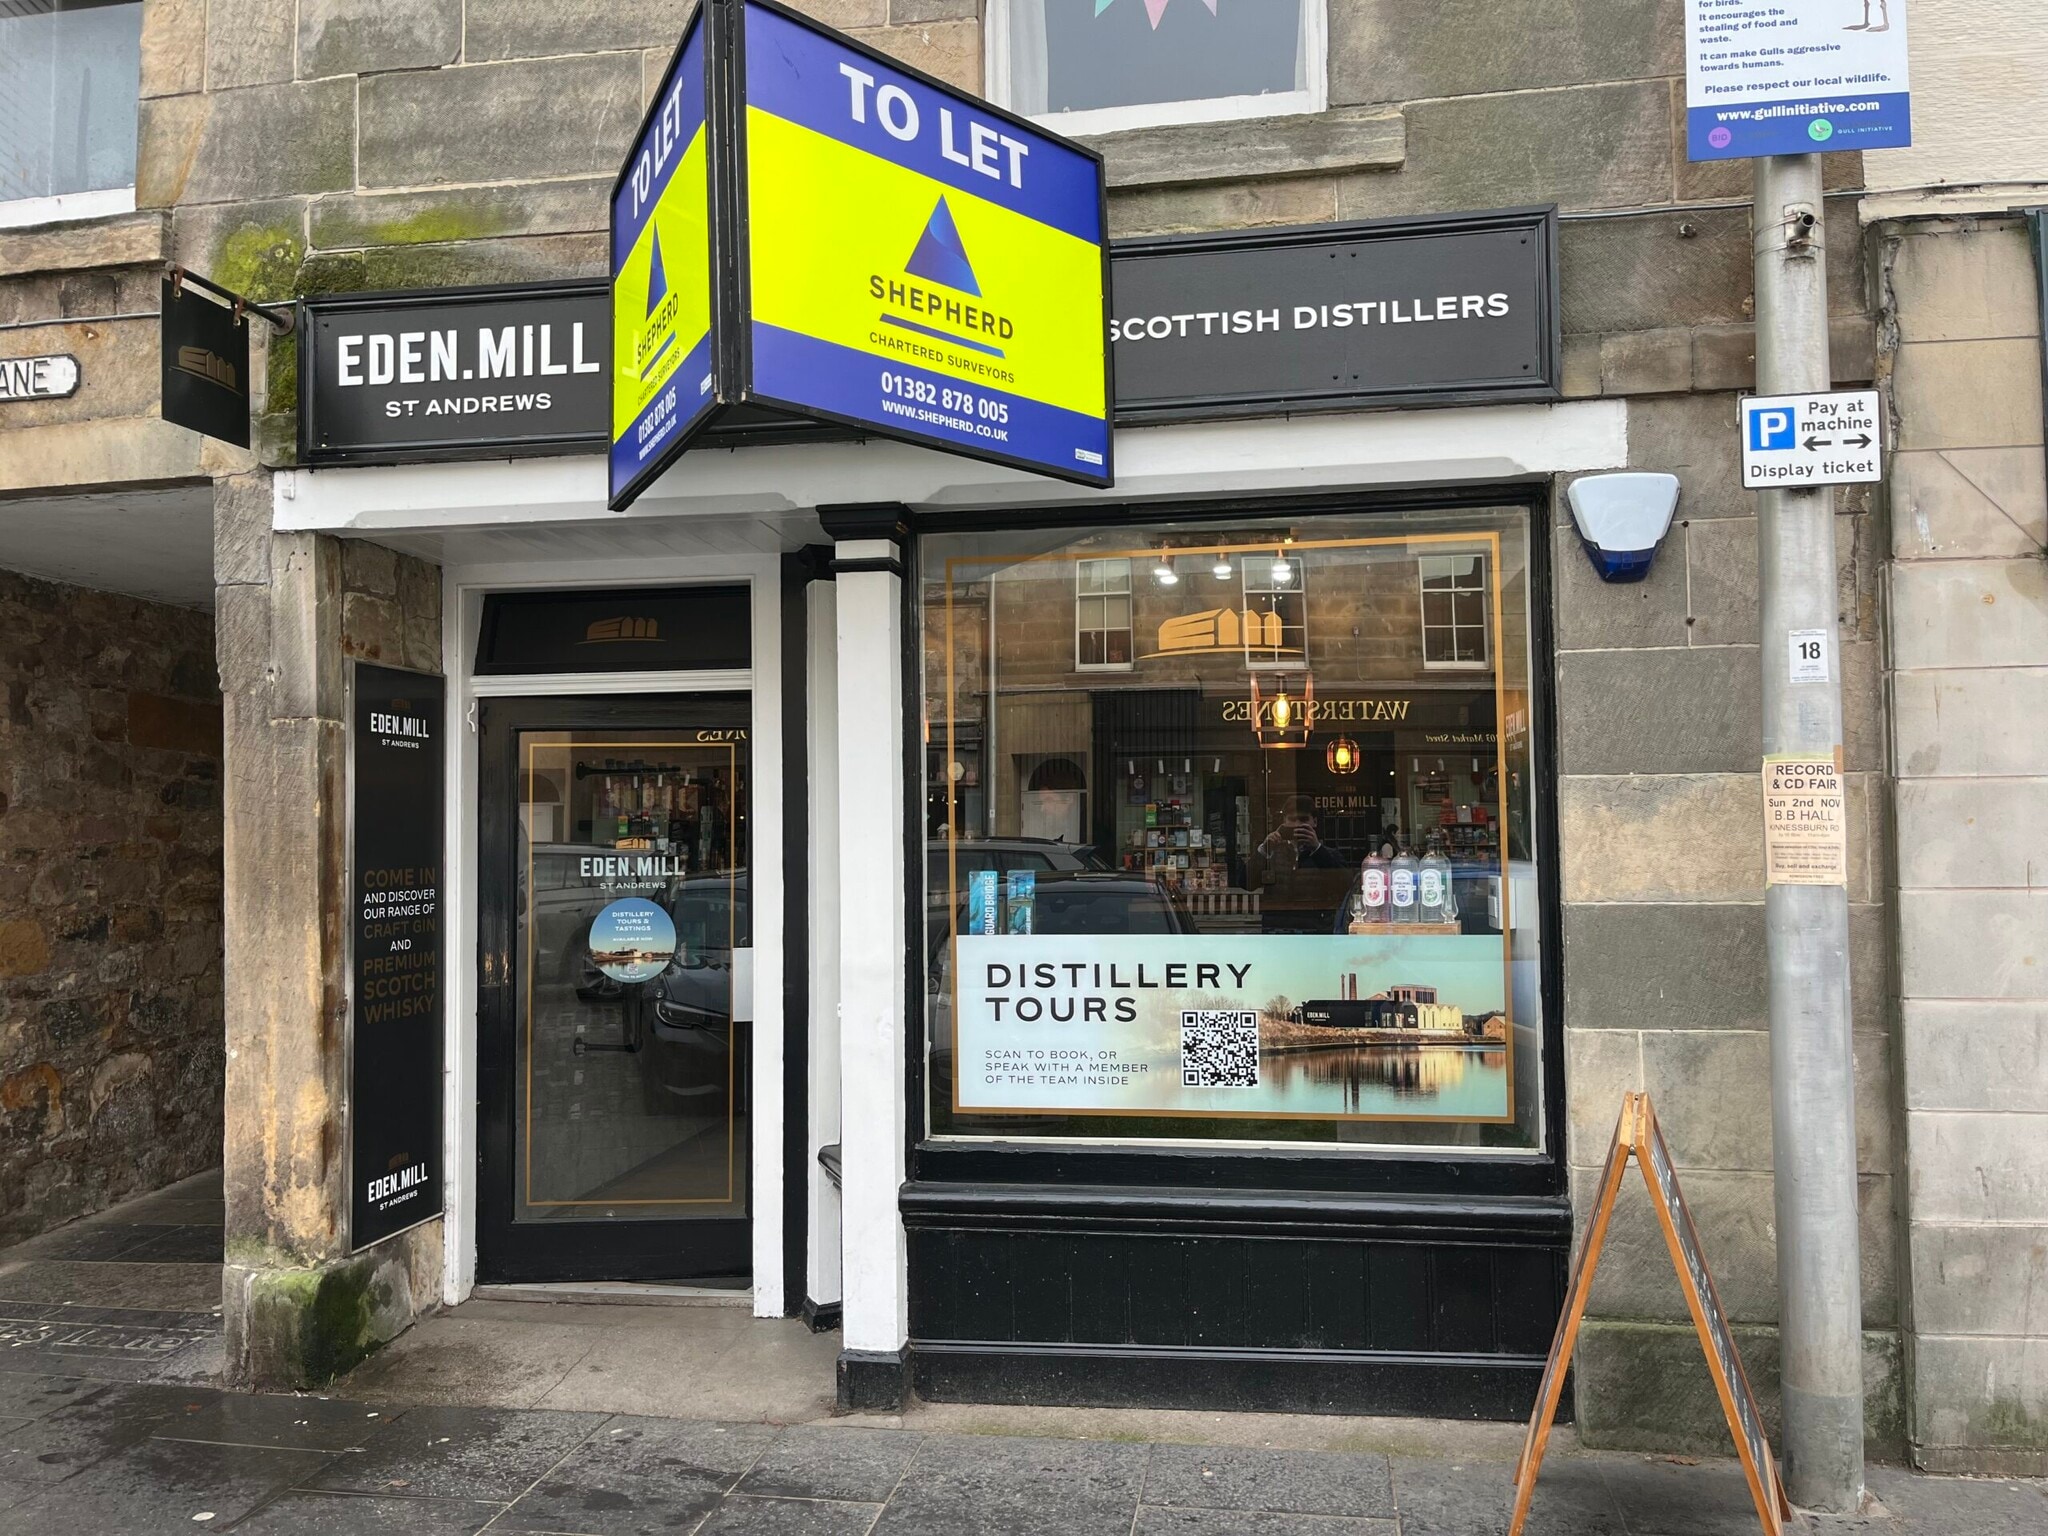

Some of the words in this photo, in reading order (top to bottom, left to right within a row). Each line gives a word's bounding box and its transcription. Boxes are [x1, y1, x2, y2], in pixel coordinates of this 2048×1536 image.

[1698, 0, 1713, 8] for
[1708, 10, 1766, 21] encourages
[1768, 8, 1785, 16] the
[1699, 23, 1739, 33] stealing
[1741, 21, 1752, 29] of
[1754, 19, 1777, 28] food
[1779, 18, 1798, 27] and
[1699, 35, 1732, 44] waste.
[1700, 53, 1708, 61] It
[1709, 52, 1728, 60] can
[1730, 49, 1757, 59] make
[1759, 47, 1785, 56] Gulls
[1787, 43, 1841, 56] aggressive
[1700, 62, 1740, 72] towards
[1742, 59, 1784, 69] humans.
[1704, 84, 1744, 94] Please
[1746, 80, 1790, 92] respect
[1792, 79, 1812, 88] our
[1814, 76, 1842, 86] local
[1844, 73, 1891, 84] wildlife.
[1716, 101, 1880, 122] www.gullinitiative.com
[839, 61, 920, 142] TO
[939, 107, 1029, 190] LET
[1857, 125, 1893, 133] INITIATIVE
[631, 147, 652, 219] TO
[654, 76, 684, 174] LET
[1711, 133, 1728, 143] BID
[869, 274, 1014, 340] SHEPHERD
[1293, 293, 1510, 330] DISTILLERS
[637, 292, 679, 365] SHEPHERD
[338, 322, 600, 387] EDEN.MILL
[869, 331, 944, 363] CHARTERED
[947, 354, 1015, 384] SURVEYORS
[385, 400, 418, 418] ST
[425, 393, 552, 416] ANDREWS
[881, 371, 937, 406] 01382
[941, 387, 974, 415] 878
[978, 397, 1009, 424] 005
[638, 410, 654, 444] 01382
[654, 398, 666, 426] 878
[665, 385, 677, 413] 005
[1808, 401, 1838, 416] Pay
[1847, 400, 1864, 412] at
[882, 399, 1009, 442] WWW.SHEPHERD.CO.UK
[1760, 412, 1787, 447] P
[1801, 417, 1873, 431] machine
[1751, 464, 1814, 479] Display
[1822, 460, 1874, 474] ticket
[1798, 641, 1821, 660] 18
[370, 712, 430, 738] EDEN.MILL
[391, 740, 420, 749] ANDREWS
[1776, 765, 1834, 776] RECORD
[1772, 779, 1781, 789] &
[1784, 778, 1804, 789] CD
[1809, 778, 1837, 790] FAIR
[1314, 796, 1377, 809] EDEN.MILL
[1768, 798, 1786, 808] Sun
[1792, 798, 1814, 808] 2nd
[1820, 798, 1840, 808] NOV
[1774, 810, 1795, 821] B.B
[1800, 810, 1834, 821] HALL
[1769, 824, 1828, 832] KINNESSBURN
[580, 856, 686, 877] EDEN.MILL
[364, 869, 415, 888] COME
[420, 867, 436, 885] IN
[600, 882, 614, 890] ST
[615, 881, 667, 889] ANDREWS
[363, 892, 387, 904] AND
[388, 889, 436, 902] DISCOVER
[984, 874, 995, 906] BRIDGE
[363, 907, 386, 920] OUR
[387, 904, 421, 918] RANGE
[422, 903, 436, 914] OF
[364, 920, 410, 939] CRAFT
[413, 918, 436, 934] GIN
[390, 939, 412, 951] AND
[363, 951, 436, 976] PREMIUM
[364, 971, 436, 1000] SCOTCH
[985, 963, 1253, 990] DISTILLERY
[364, 993, 435, 1024] WHISKY
[985, 996, 1138, 1023] TOURS
[985, 1050, 1022, 1059] SCAN
[1027, 1050, 1045, 1059] TO
[1050, 1050, 1094, 1061] BOOK,
[1098, 1051, 1117, 1060] OR
[985, 1062, 1030, 1071] SPEAK
[1034, 1063, 1070, 1072] WITH
[1075, 1063, 1084, 1072] A
[1089, 1063, 1149, 1073] MEMBER
[985, 1075, 1003, 1084] OF
[1008, 1075, 1035, 1084] THE
[1040, 1075, 1078, 1085] TEAM
[1083, 1076, 1129, 1085] INSIDE
[368, 1162, 429, 1203] EDEN.MILL
[380, 1201, 389, 1211] ST
[388, 1189, 418, 1208] ANDREWS
